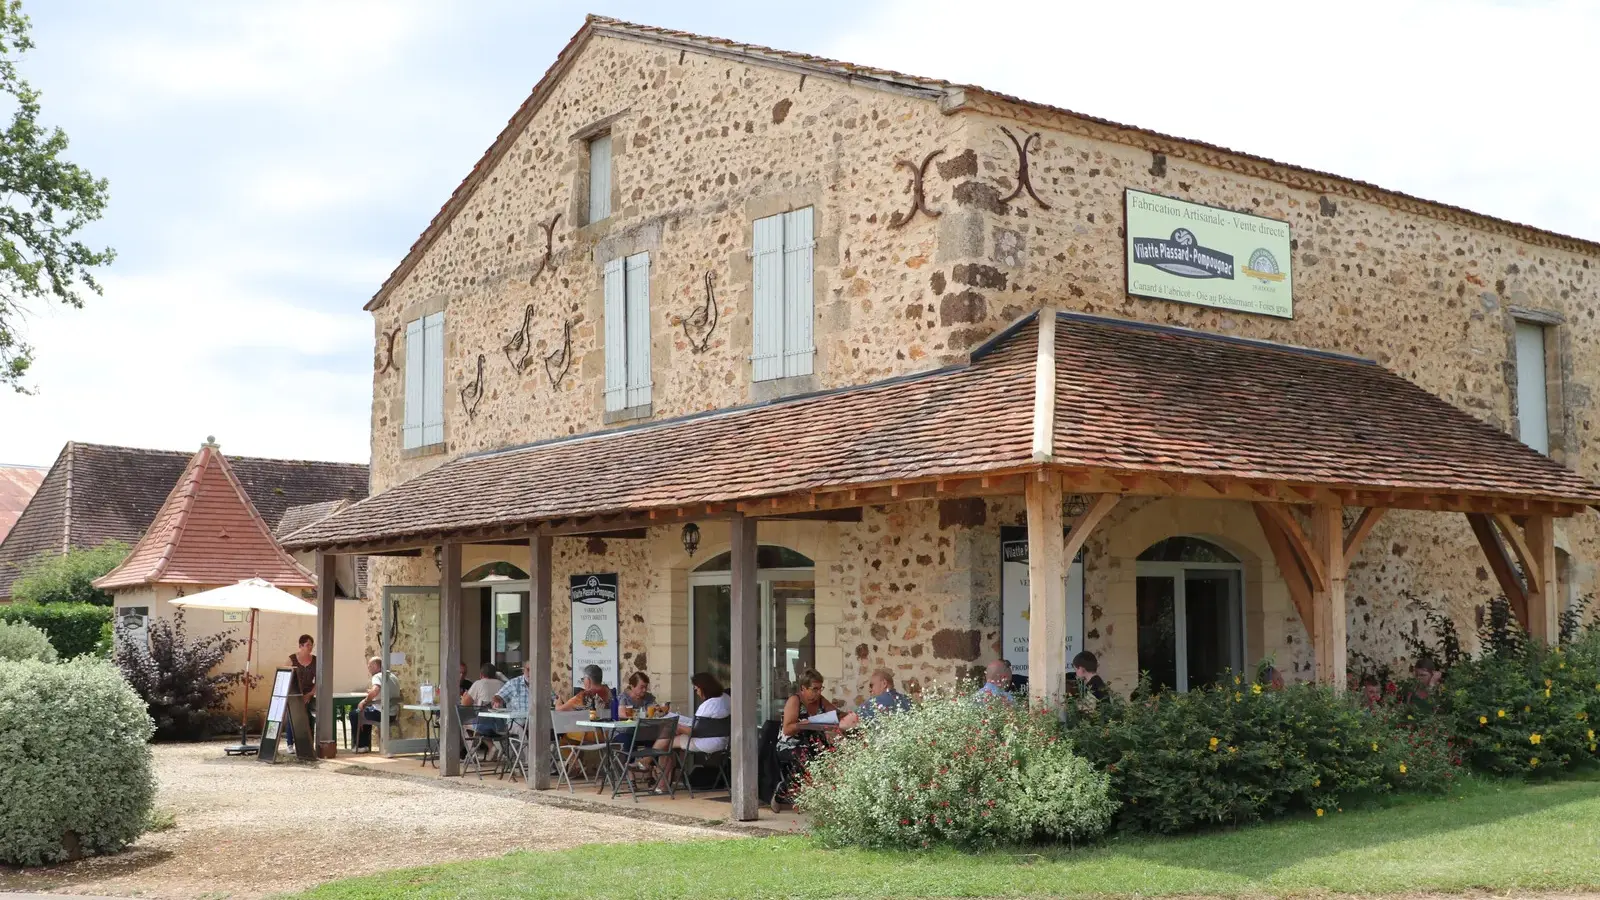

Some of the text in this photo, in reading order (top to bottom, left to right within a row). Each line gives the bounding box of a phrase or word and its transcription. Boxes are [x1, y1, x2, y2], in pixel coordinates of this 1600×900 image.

[1132, 196, 1181, 217] Fabrication
[1183, 208, 1225, 226] Artisanale
[1233, 216, 1257, 232] Vente
[1258, 222, 1285, 238] directe
[1134, 243, 1159, 259] Vilatte
[1160, 243, 1189, 261] Plassard
[1193, 248, 1232, 275] Pompougnac
[1133, 280, 1157, 292] Canard
[1163, 285, 1190, 298] l'abricot
[1196, 291, 1208, 301] Oie
[1259, 300, 1275, 312] Foies
[1276, 304, 1288, 314] gras
[1004, 545, 1024, 559] Vilatte
